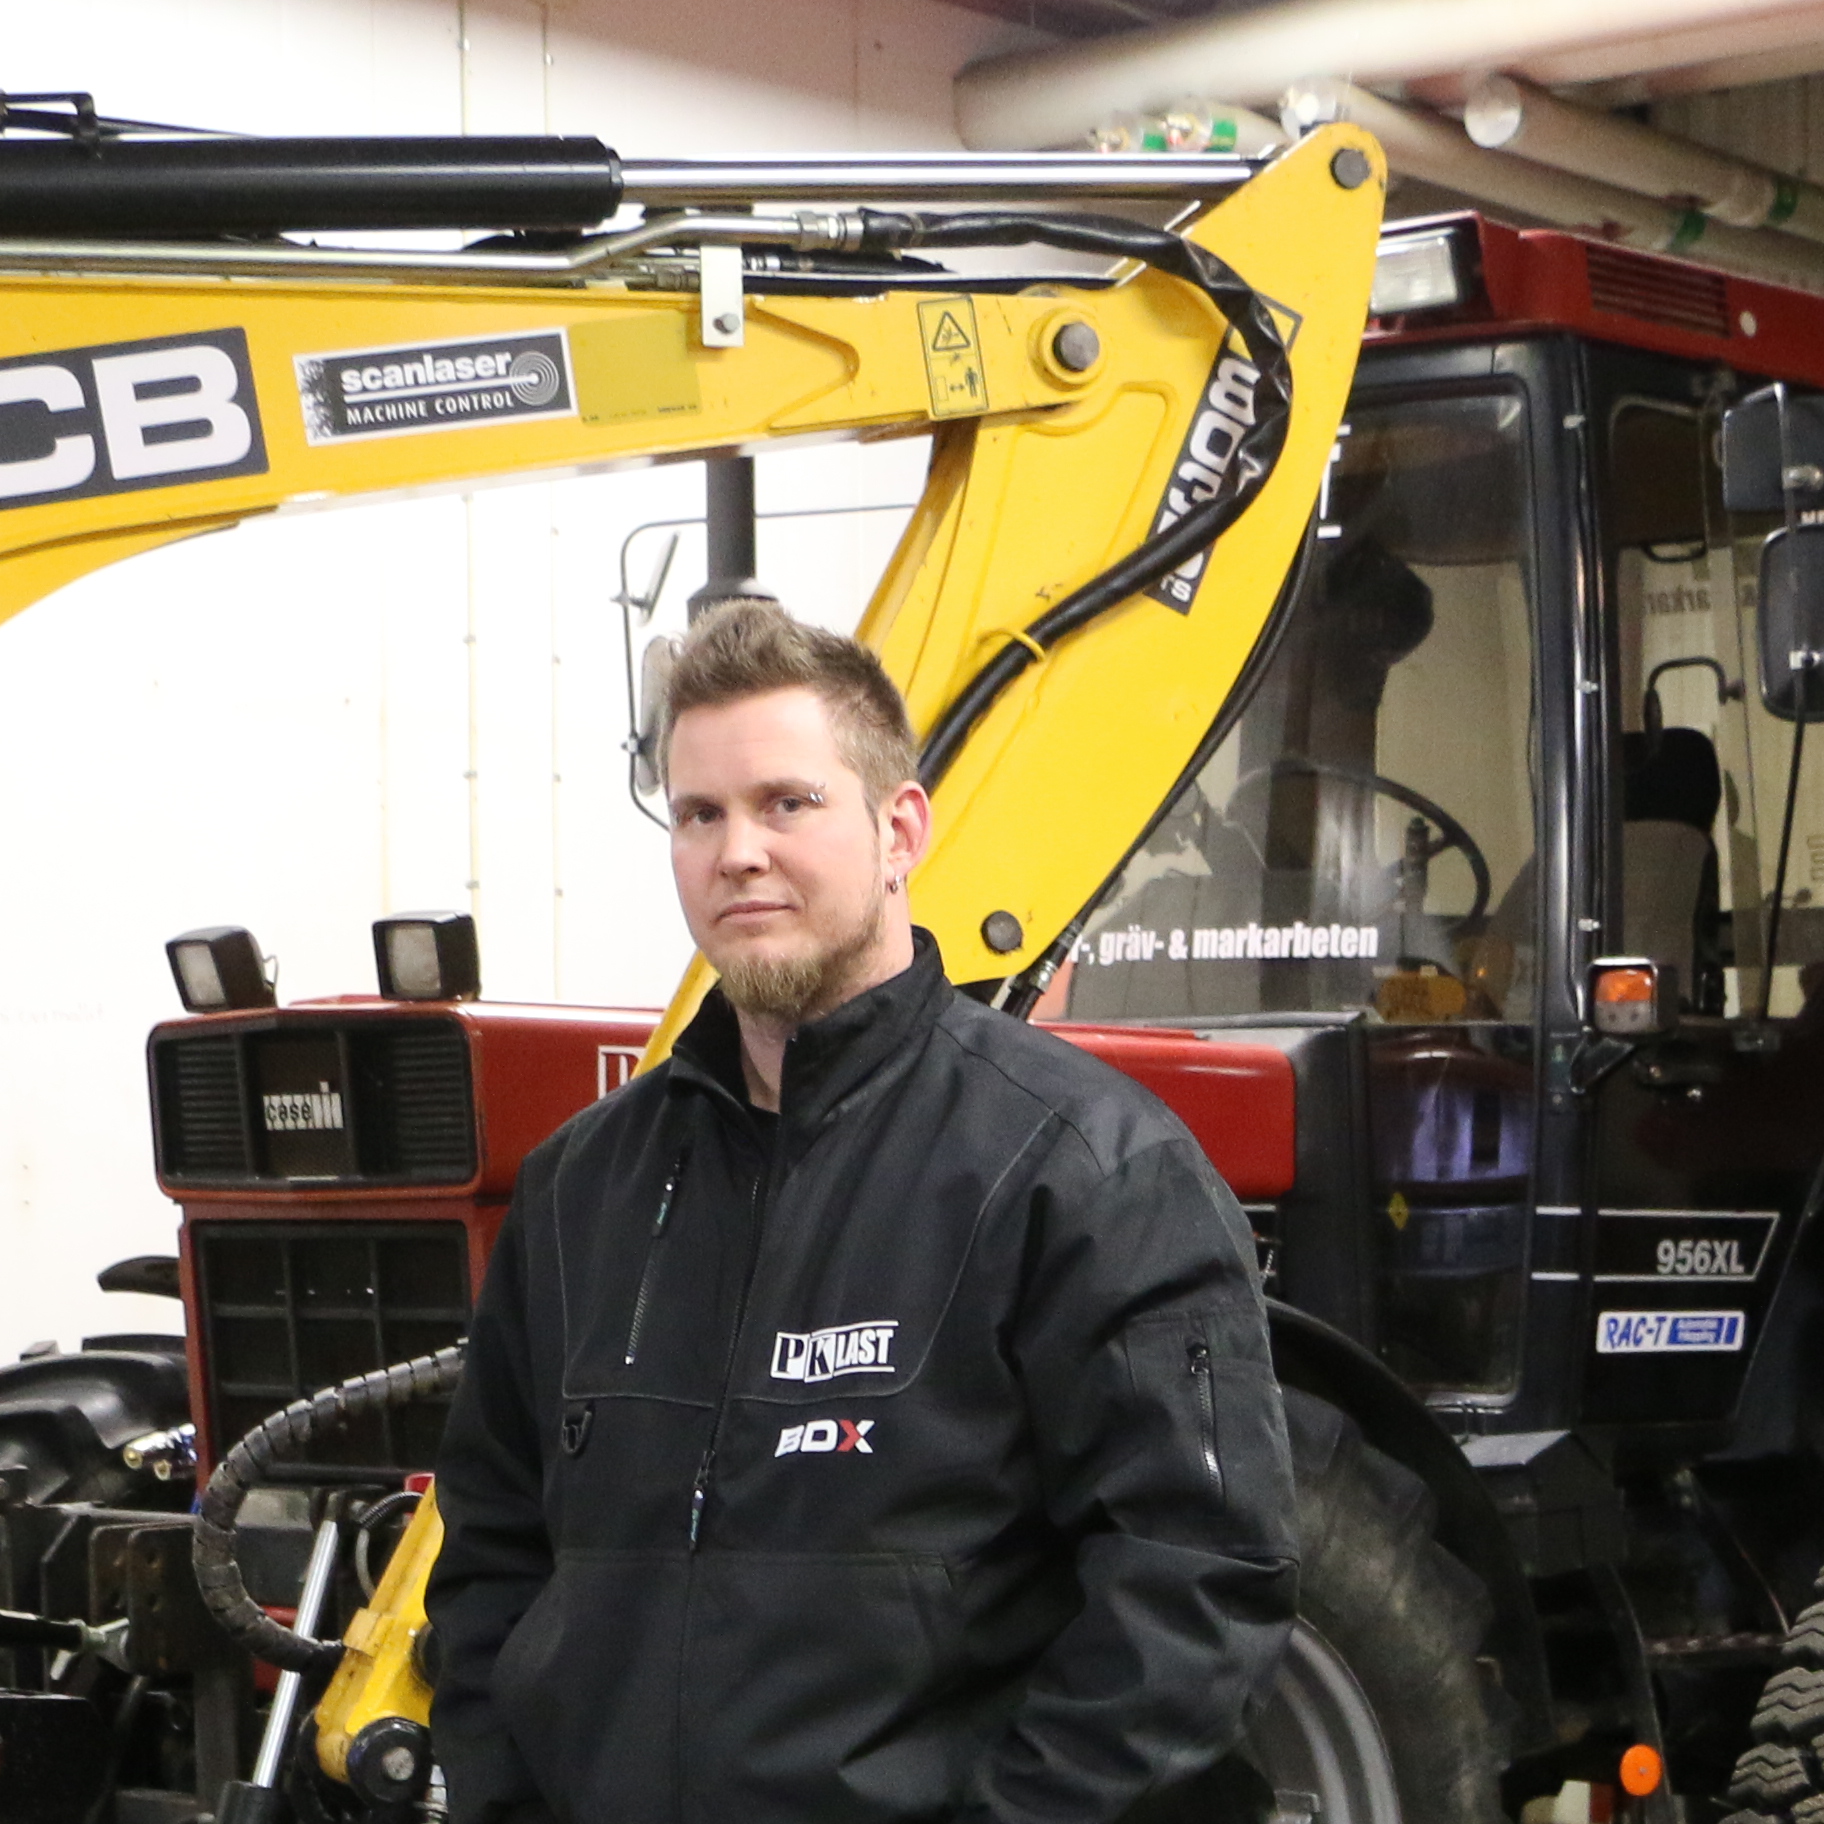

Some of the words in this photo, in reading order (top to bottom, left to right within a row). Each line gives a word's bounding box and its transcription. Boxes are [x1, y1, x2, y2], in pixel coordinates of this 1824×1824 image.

[340, 351, 513, 393] scanlaser
[345, 400, 429, 426] MACHINE
[434, 390, 514, 416] CONTROL
[1099, 924, 1165, 966] gräv-
[1168, 929, 1189, 960] &
[1192, 921, 1379, 960] markarbeten
[1655, 1239, 1745, 1275] 956XL
[1605, 1316, 1667, 1350] RAC-T
